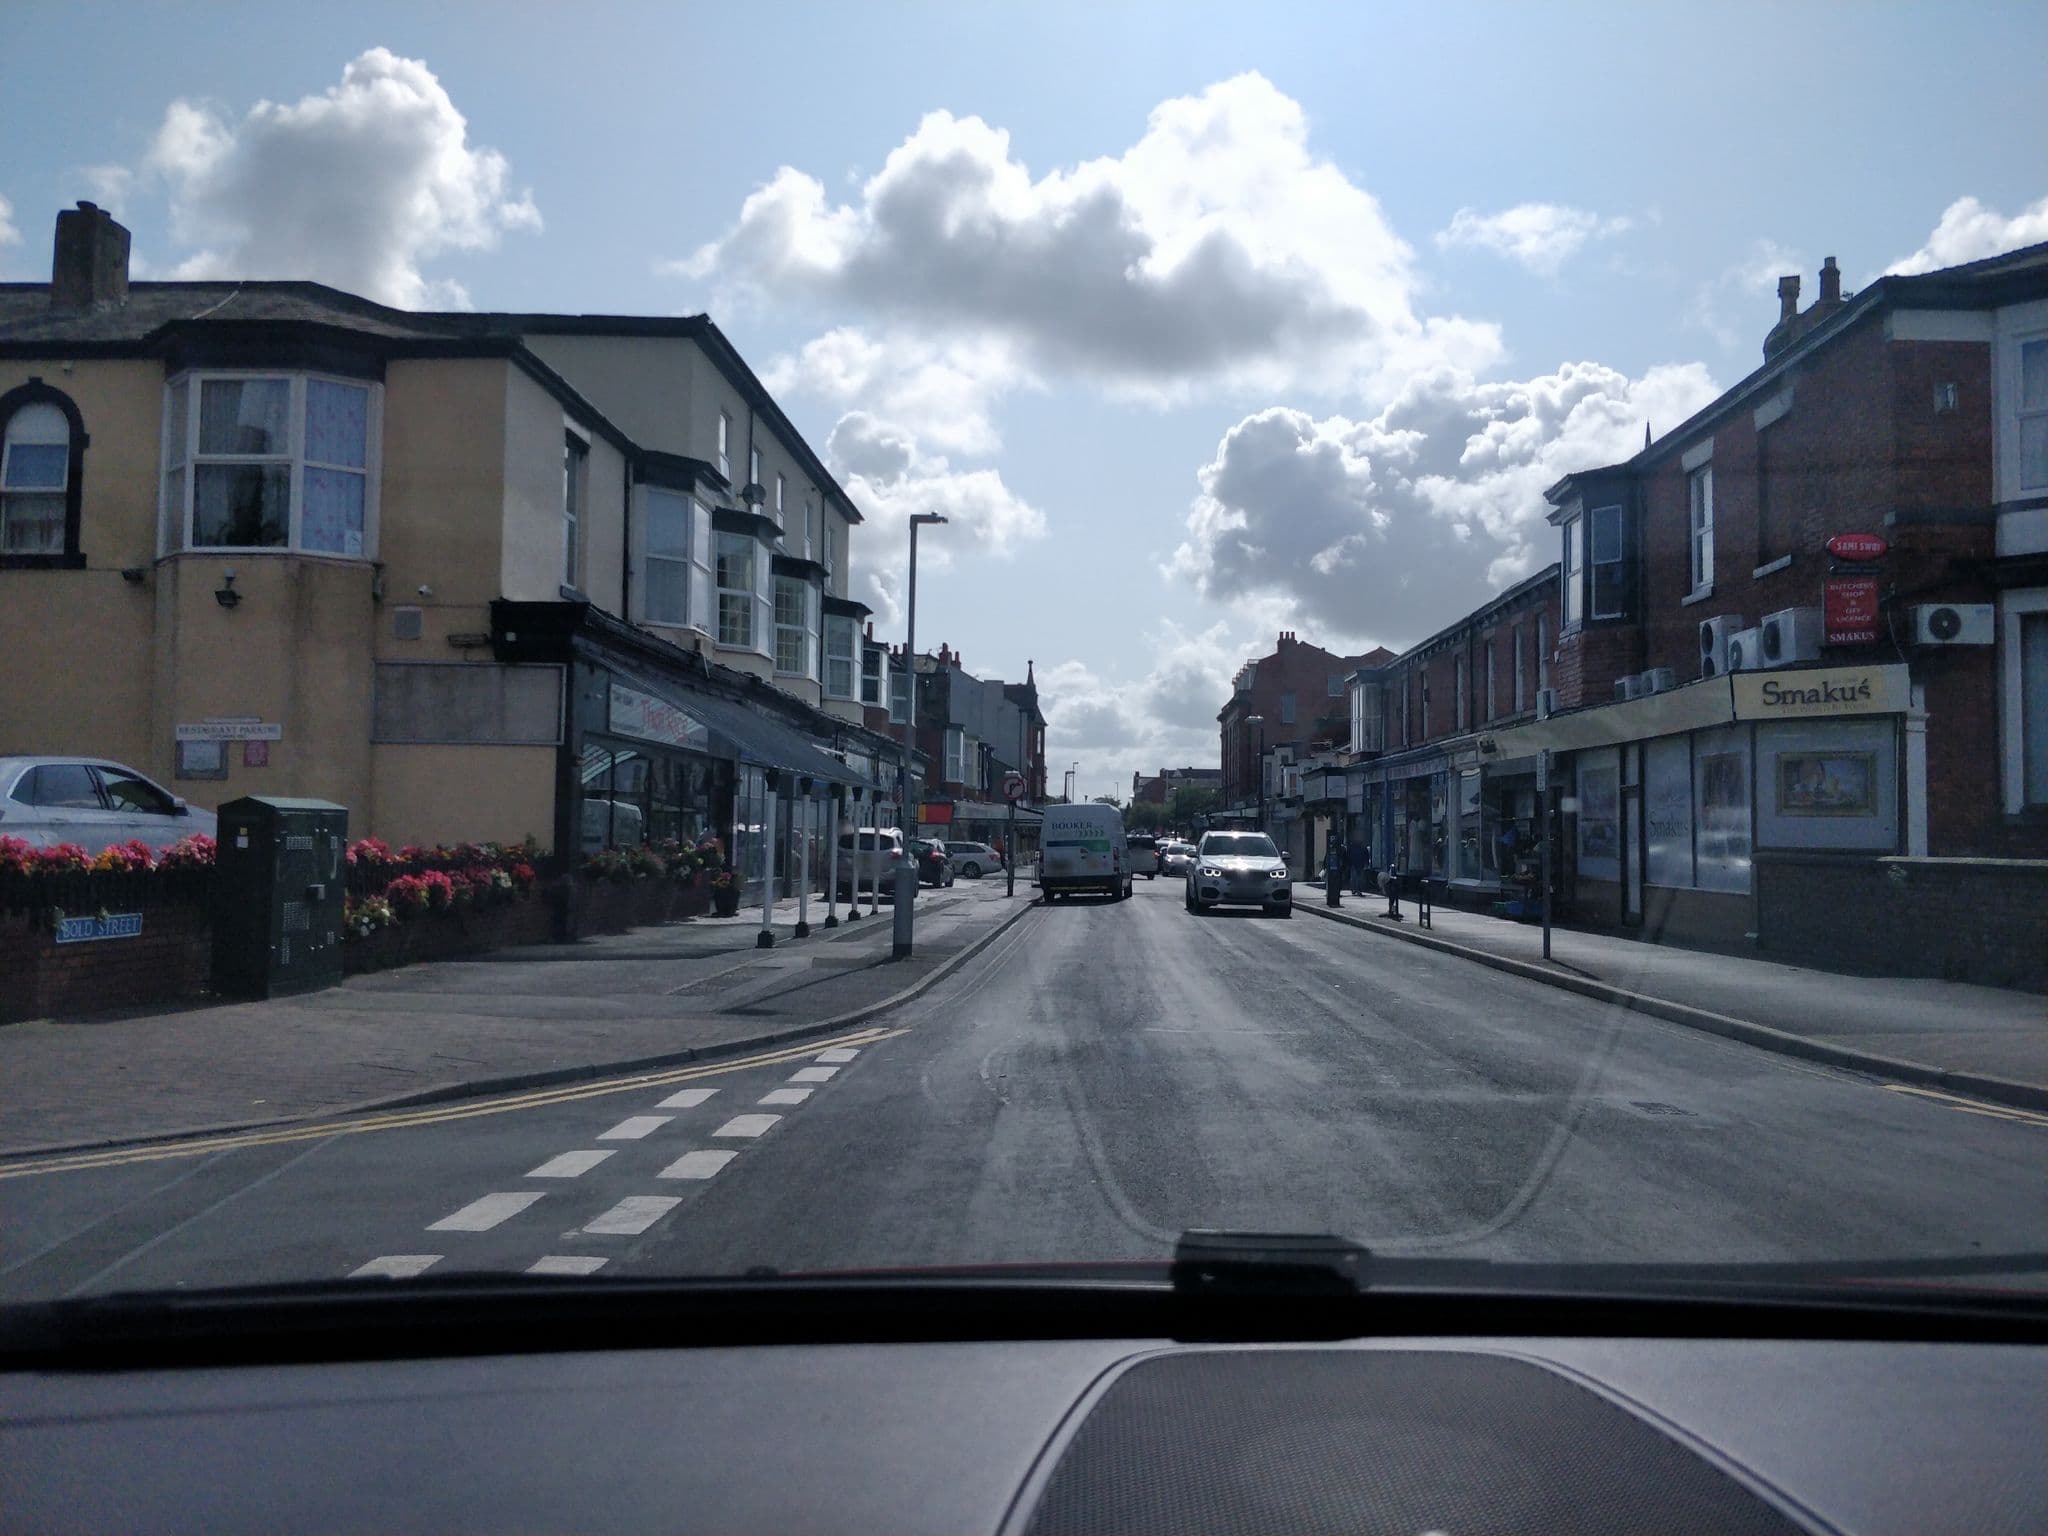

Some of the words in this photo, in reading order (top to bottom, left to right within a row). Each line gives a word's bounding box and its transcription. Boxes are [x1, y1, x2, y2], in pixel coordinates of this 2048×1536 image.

[1841, 591, 1865, 599] SHOP
[1051, 822, 1092, 830] BOOKER
[98, 918, 139, 935] STREET
